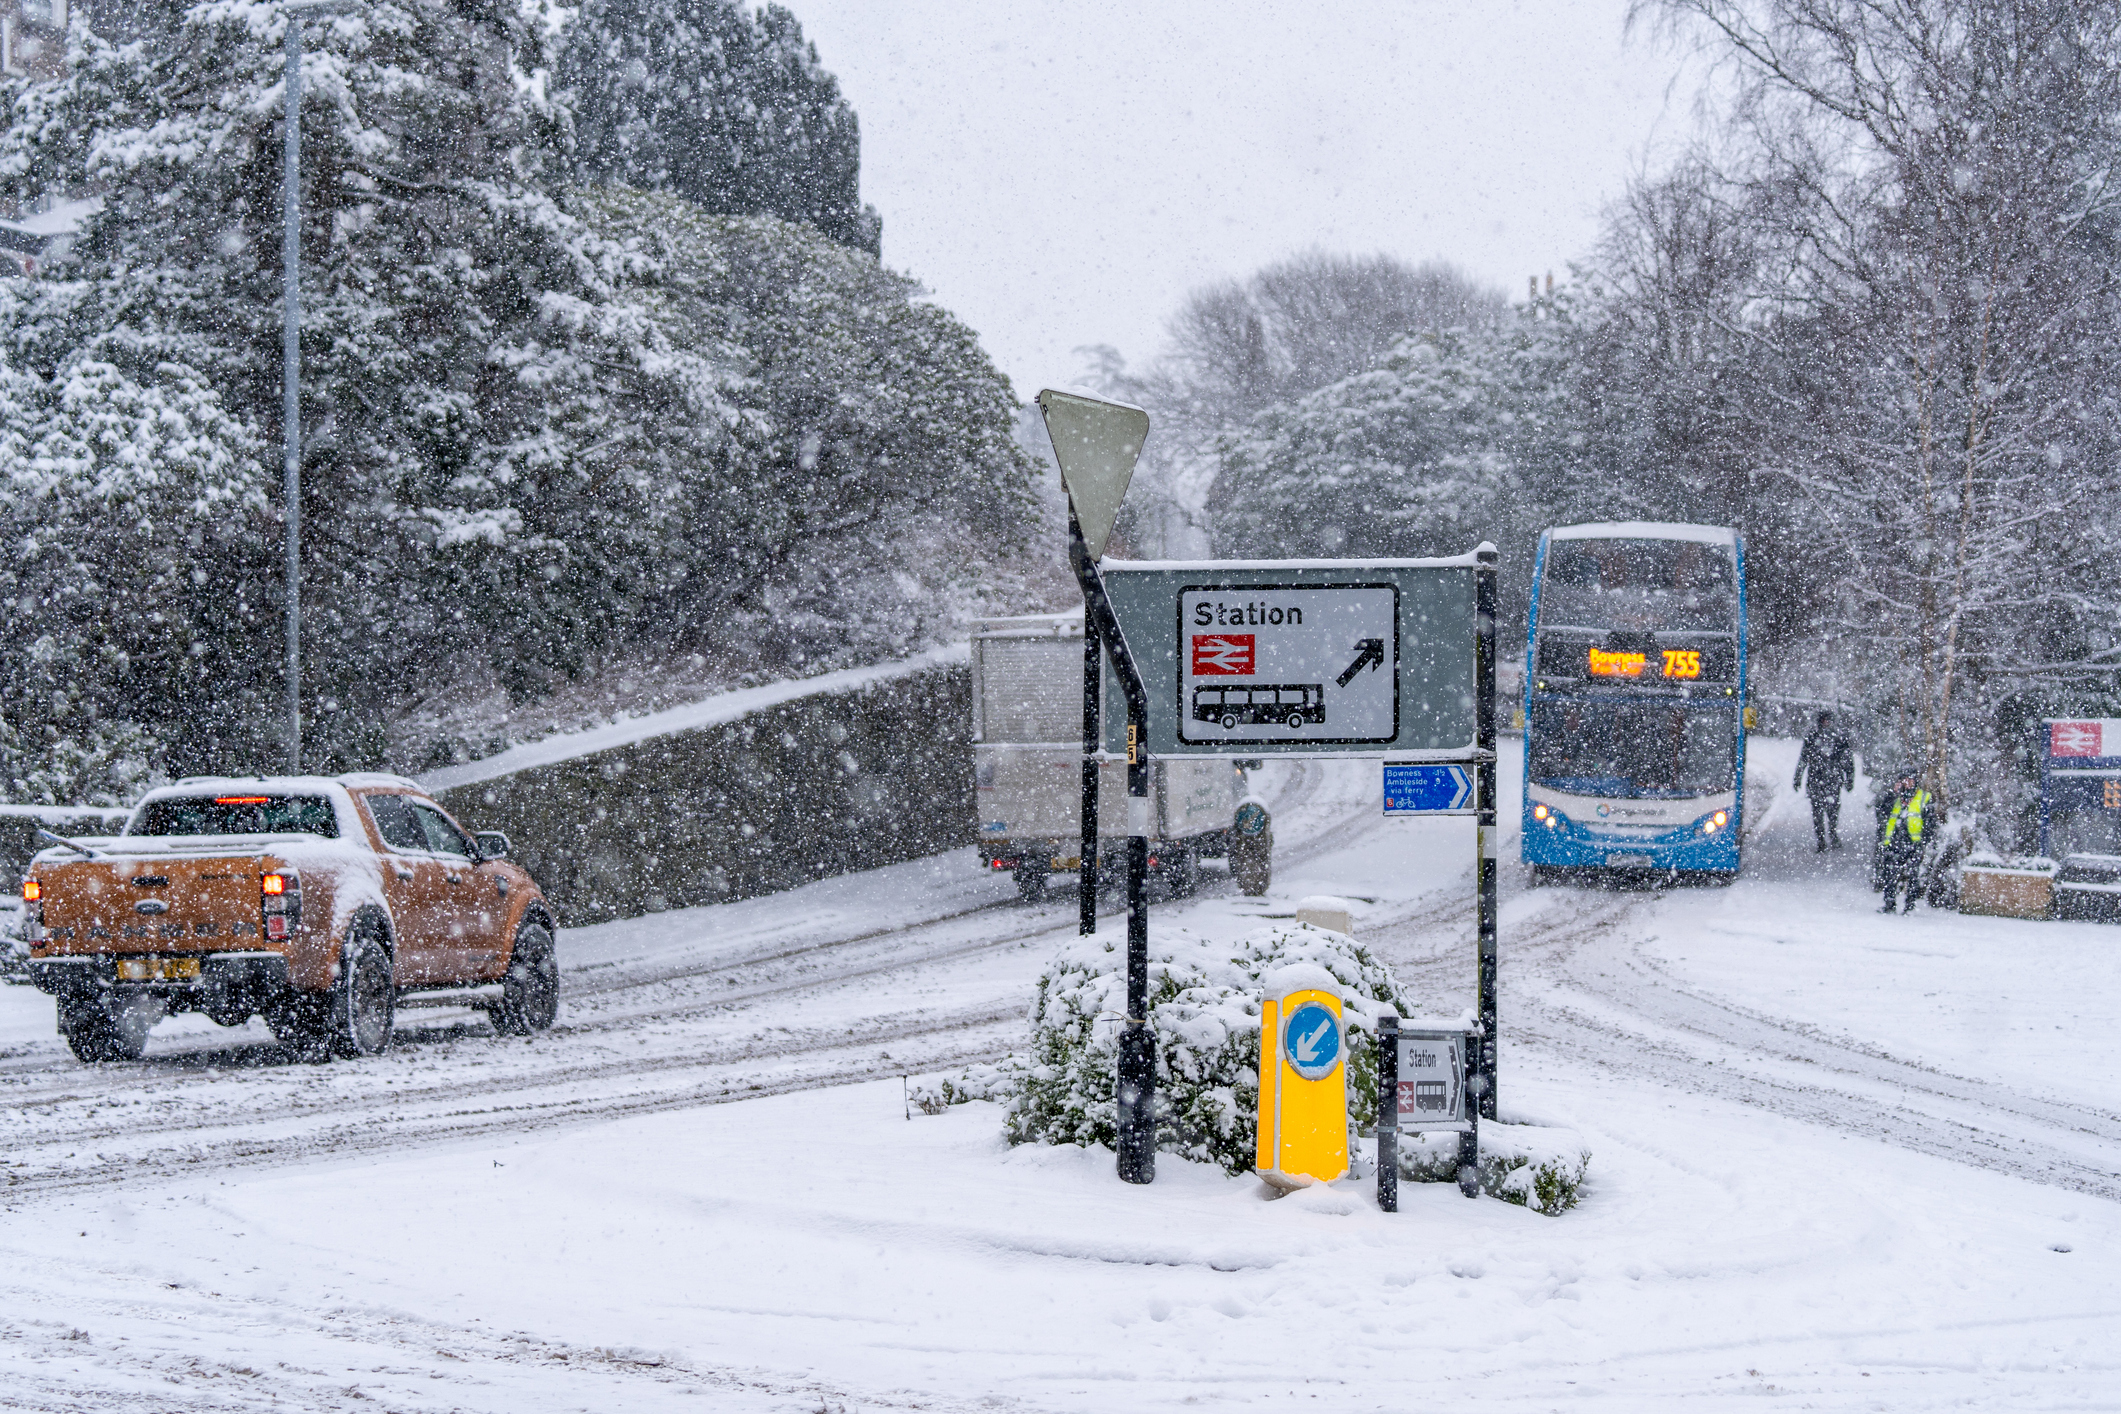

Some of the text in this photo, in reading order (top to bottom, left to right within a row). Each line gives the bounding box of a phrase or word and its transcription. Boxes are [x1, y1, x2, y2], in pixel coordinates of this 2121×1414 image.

[1194, 601, 1303, 626] Station
[1589, 648, 1646, 664] Bowness
[1662, 650, 1701, 678] 755
[1386, 769, 1422, 777] Bowness
[1386, 778, 1428, 786] Ambleside
[1404, 786, 1424, 795] ferry
[1408, 1048, 1437, 1068] Station
